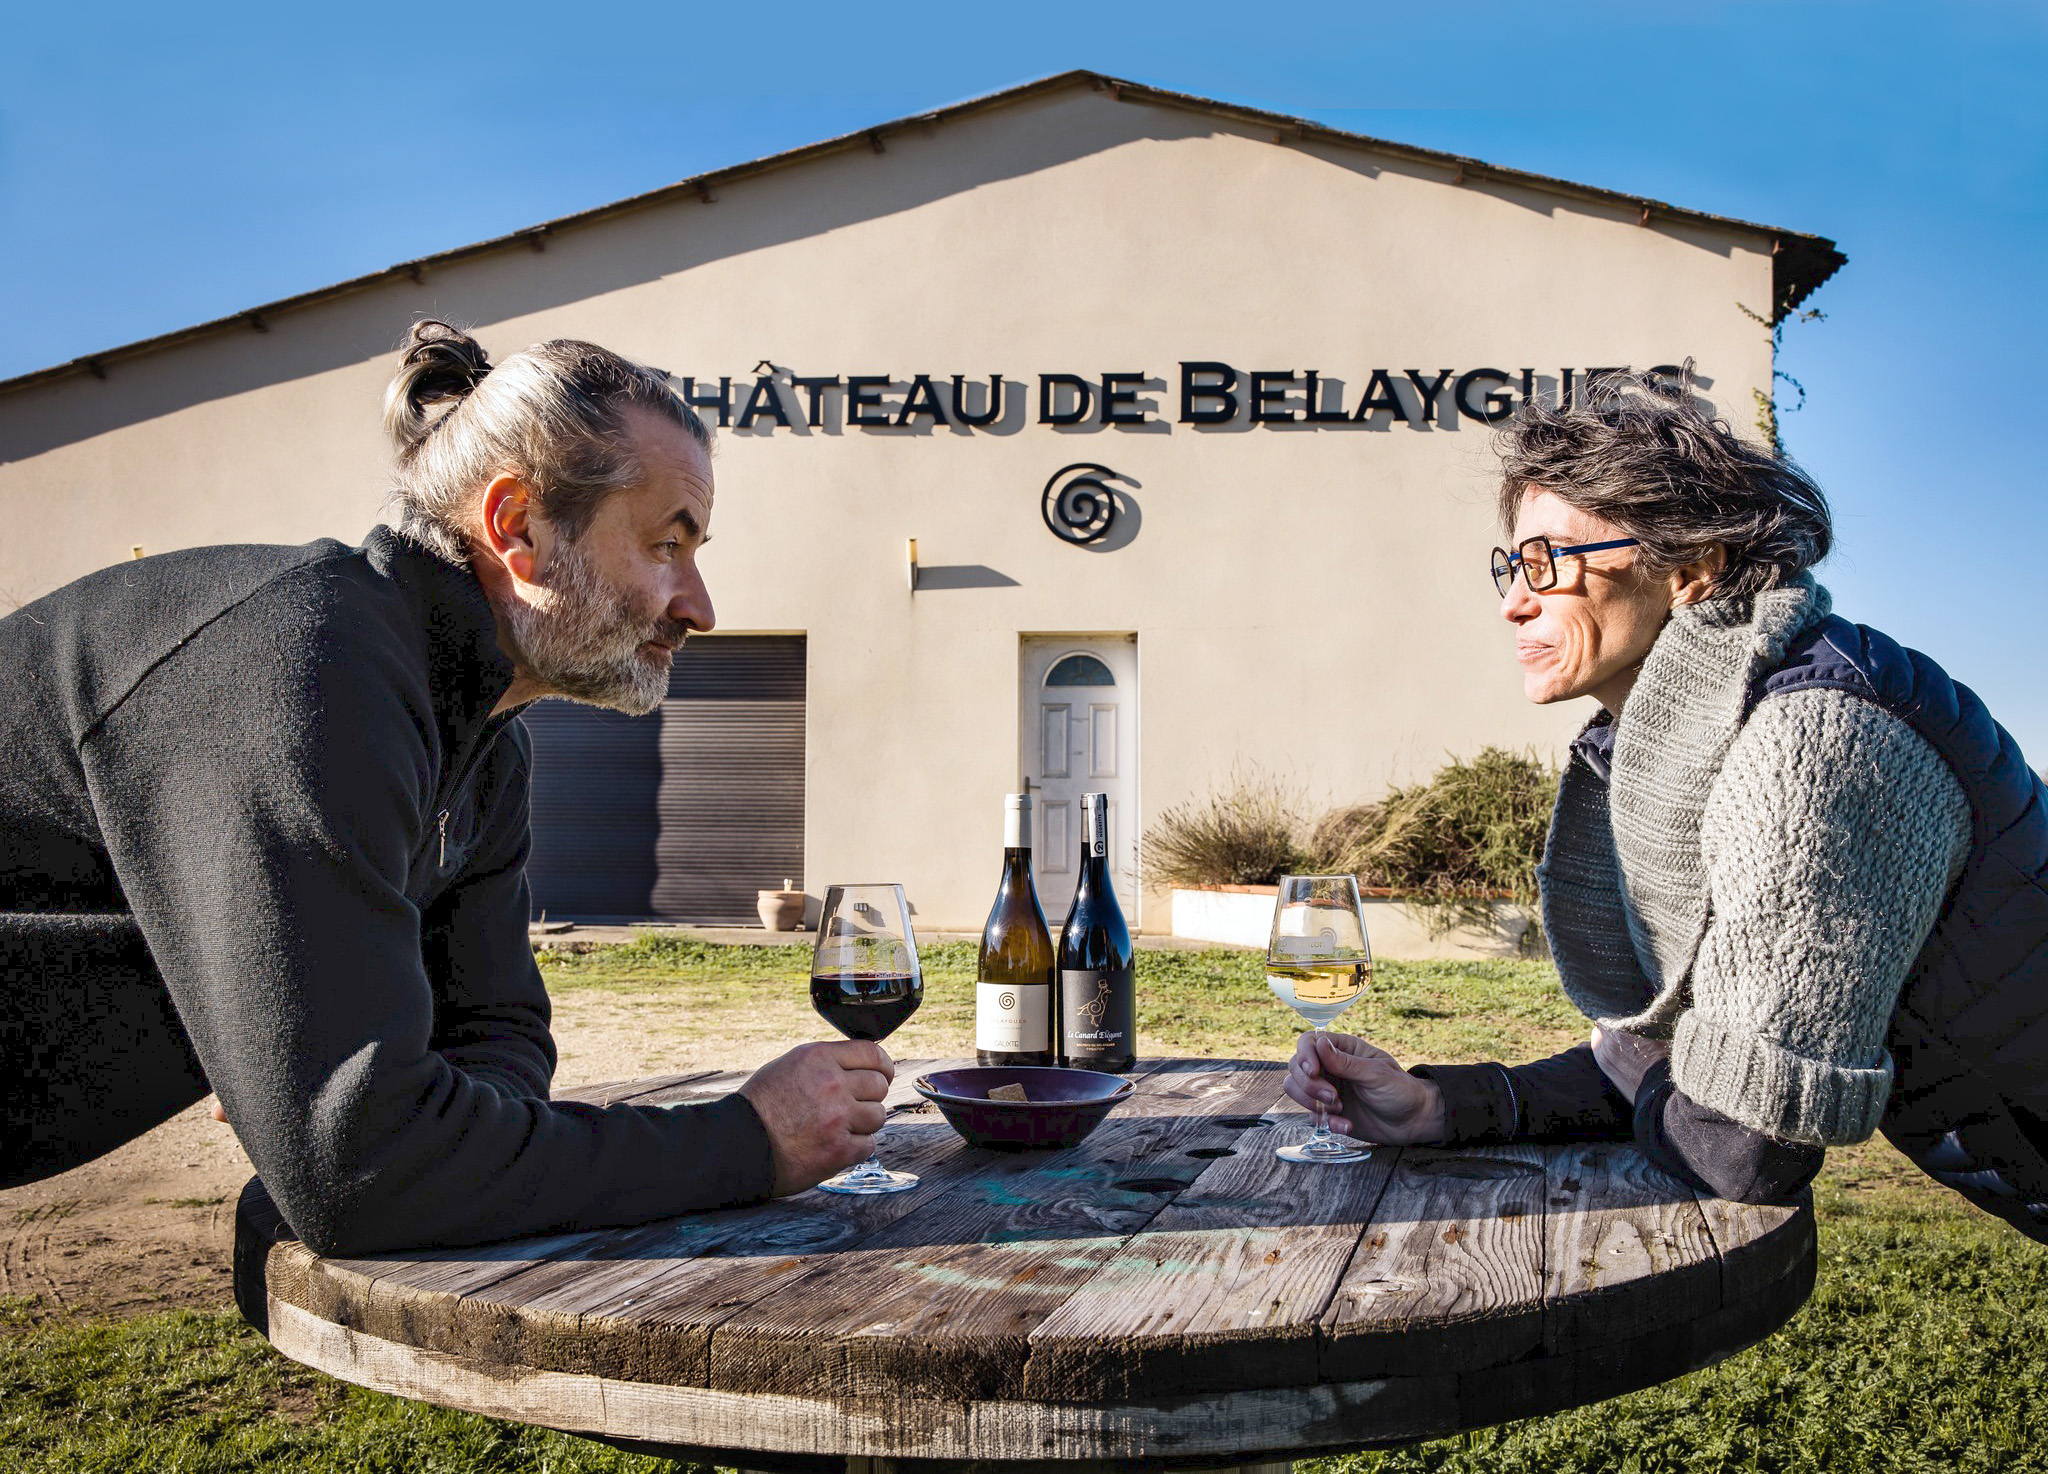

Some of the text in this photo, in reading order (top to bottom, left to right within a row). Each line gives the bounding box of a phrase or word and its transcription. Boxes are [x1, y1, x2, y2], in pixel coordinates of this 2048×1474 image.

[668, 360, 1003, 427] HÂTEAU
[1037, 371, 1145, 425] DE
[1067, 1030, 1074, 1038] Le
[1074, 1030, 1099, 1039] Canard
